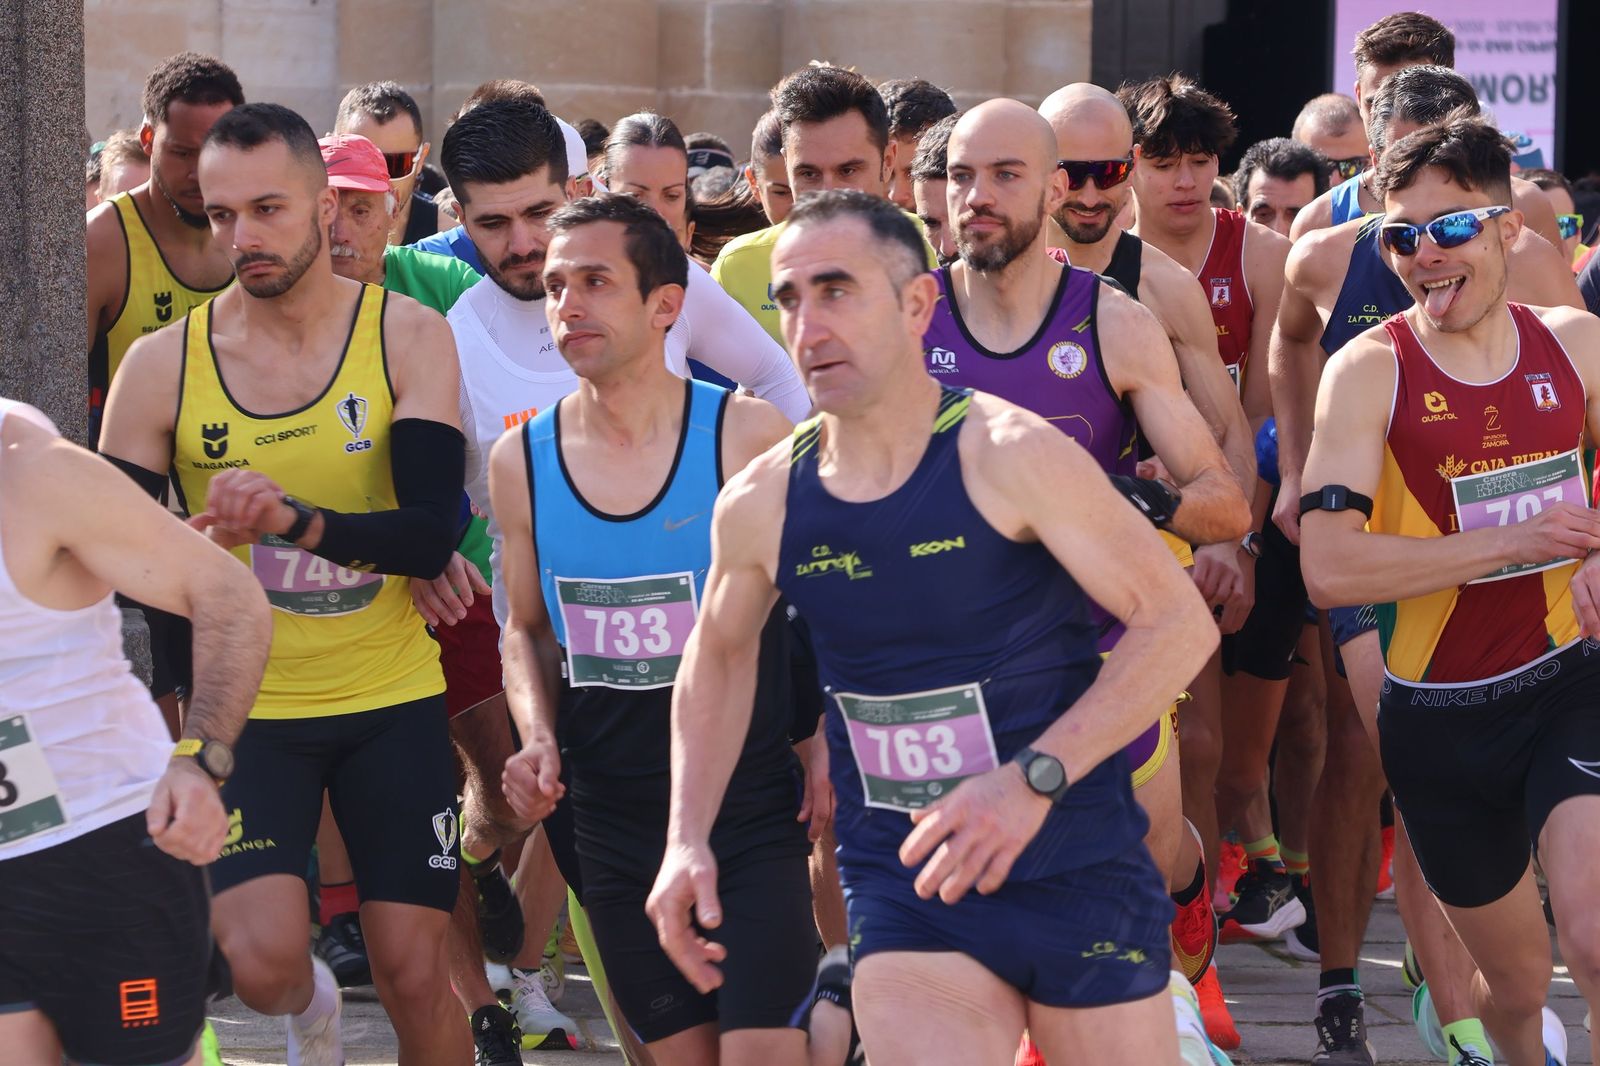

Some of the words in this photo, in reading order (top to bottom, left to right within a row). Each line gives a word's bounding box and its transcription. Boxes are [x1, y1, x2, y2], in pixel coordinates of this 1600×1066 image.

[1362, 304, 1379, 313] C.D.
[255, 435, 276, 446] CCI
[278, 424, 318, 442] SPORT
[345, 440, 372, 453] GCB
[1482, 440, 1509, 448] ZAMORA
[1483, 471, 1517, 483] Carrera
[584, 607, 672, 656] 733
[1411, 686, 1489, 707] NIKE
[1493, 659, 1561, 700] PRO
[866, 725, 963, 777] 763
[429, 855, 457, 869] GCB
